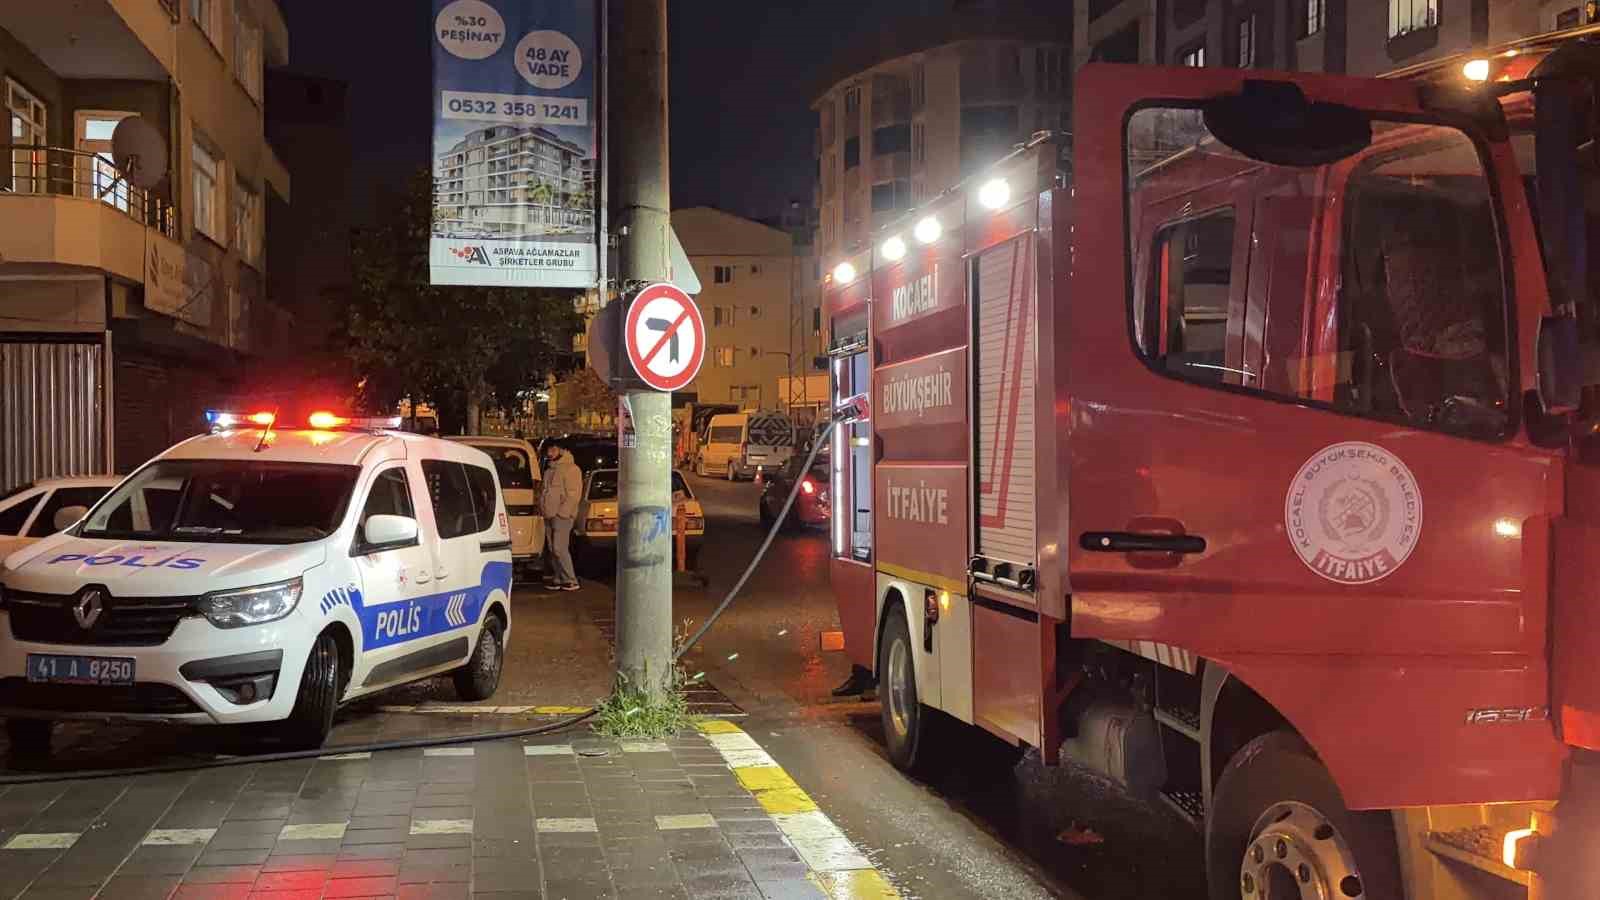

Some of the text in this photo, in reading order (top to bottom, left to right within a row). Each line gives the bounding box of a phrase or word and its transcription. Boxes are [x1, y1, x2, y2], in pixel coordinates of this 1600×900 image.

[454, 15, 487, 27] %30
[440, 29, 501, 43] PEŞİNAT
[526, 47, 569, 63] 48 AY
[527, 63, 569, 78] VADE
[449, 99, 578, 119] 0532 358 1241
[545, 258, 574, 267] GRUBU
[892, 263, 938, 321] KOCAELİ
[883, 364, 953, 417] BÜYÜKŞEHİR
[887, 477, 948, 525] İTFAİYE
[1316, 552, 1388, 580] İTFAİYE
[375, 600, 421, 641] POLİS
[38, 657, 132, 679] 41 A 8250
